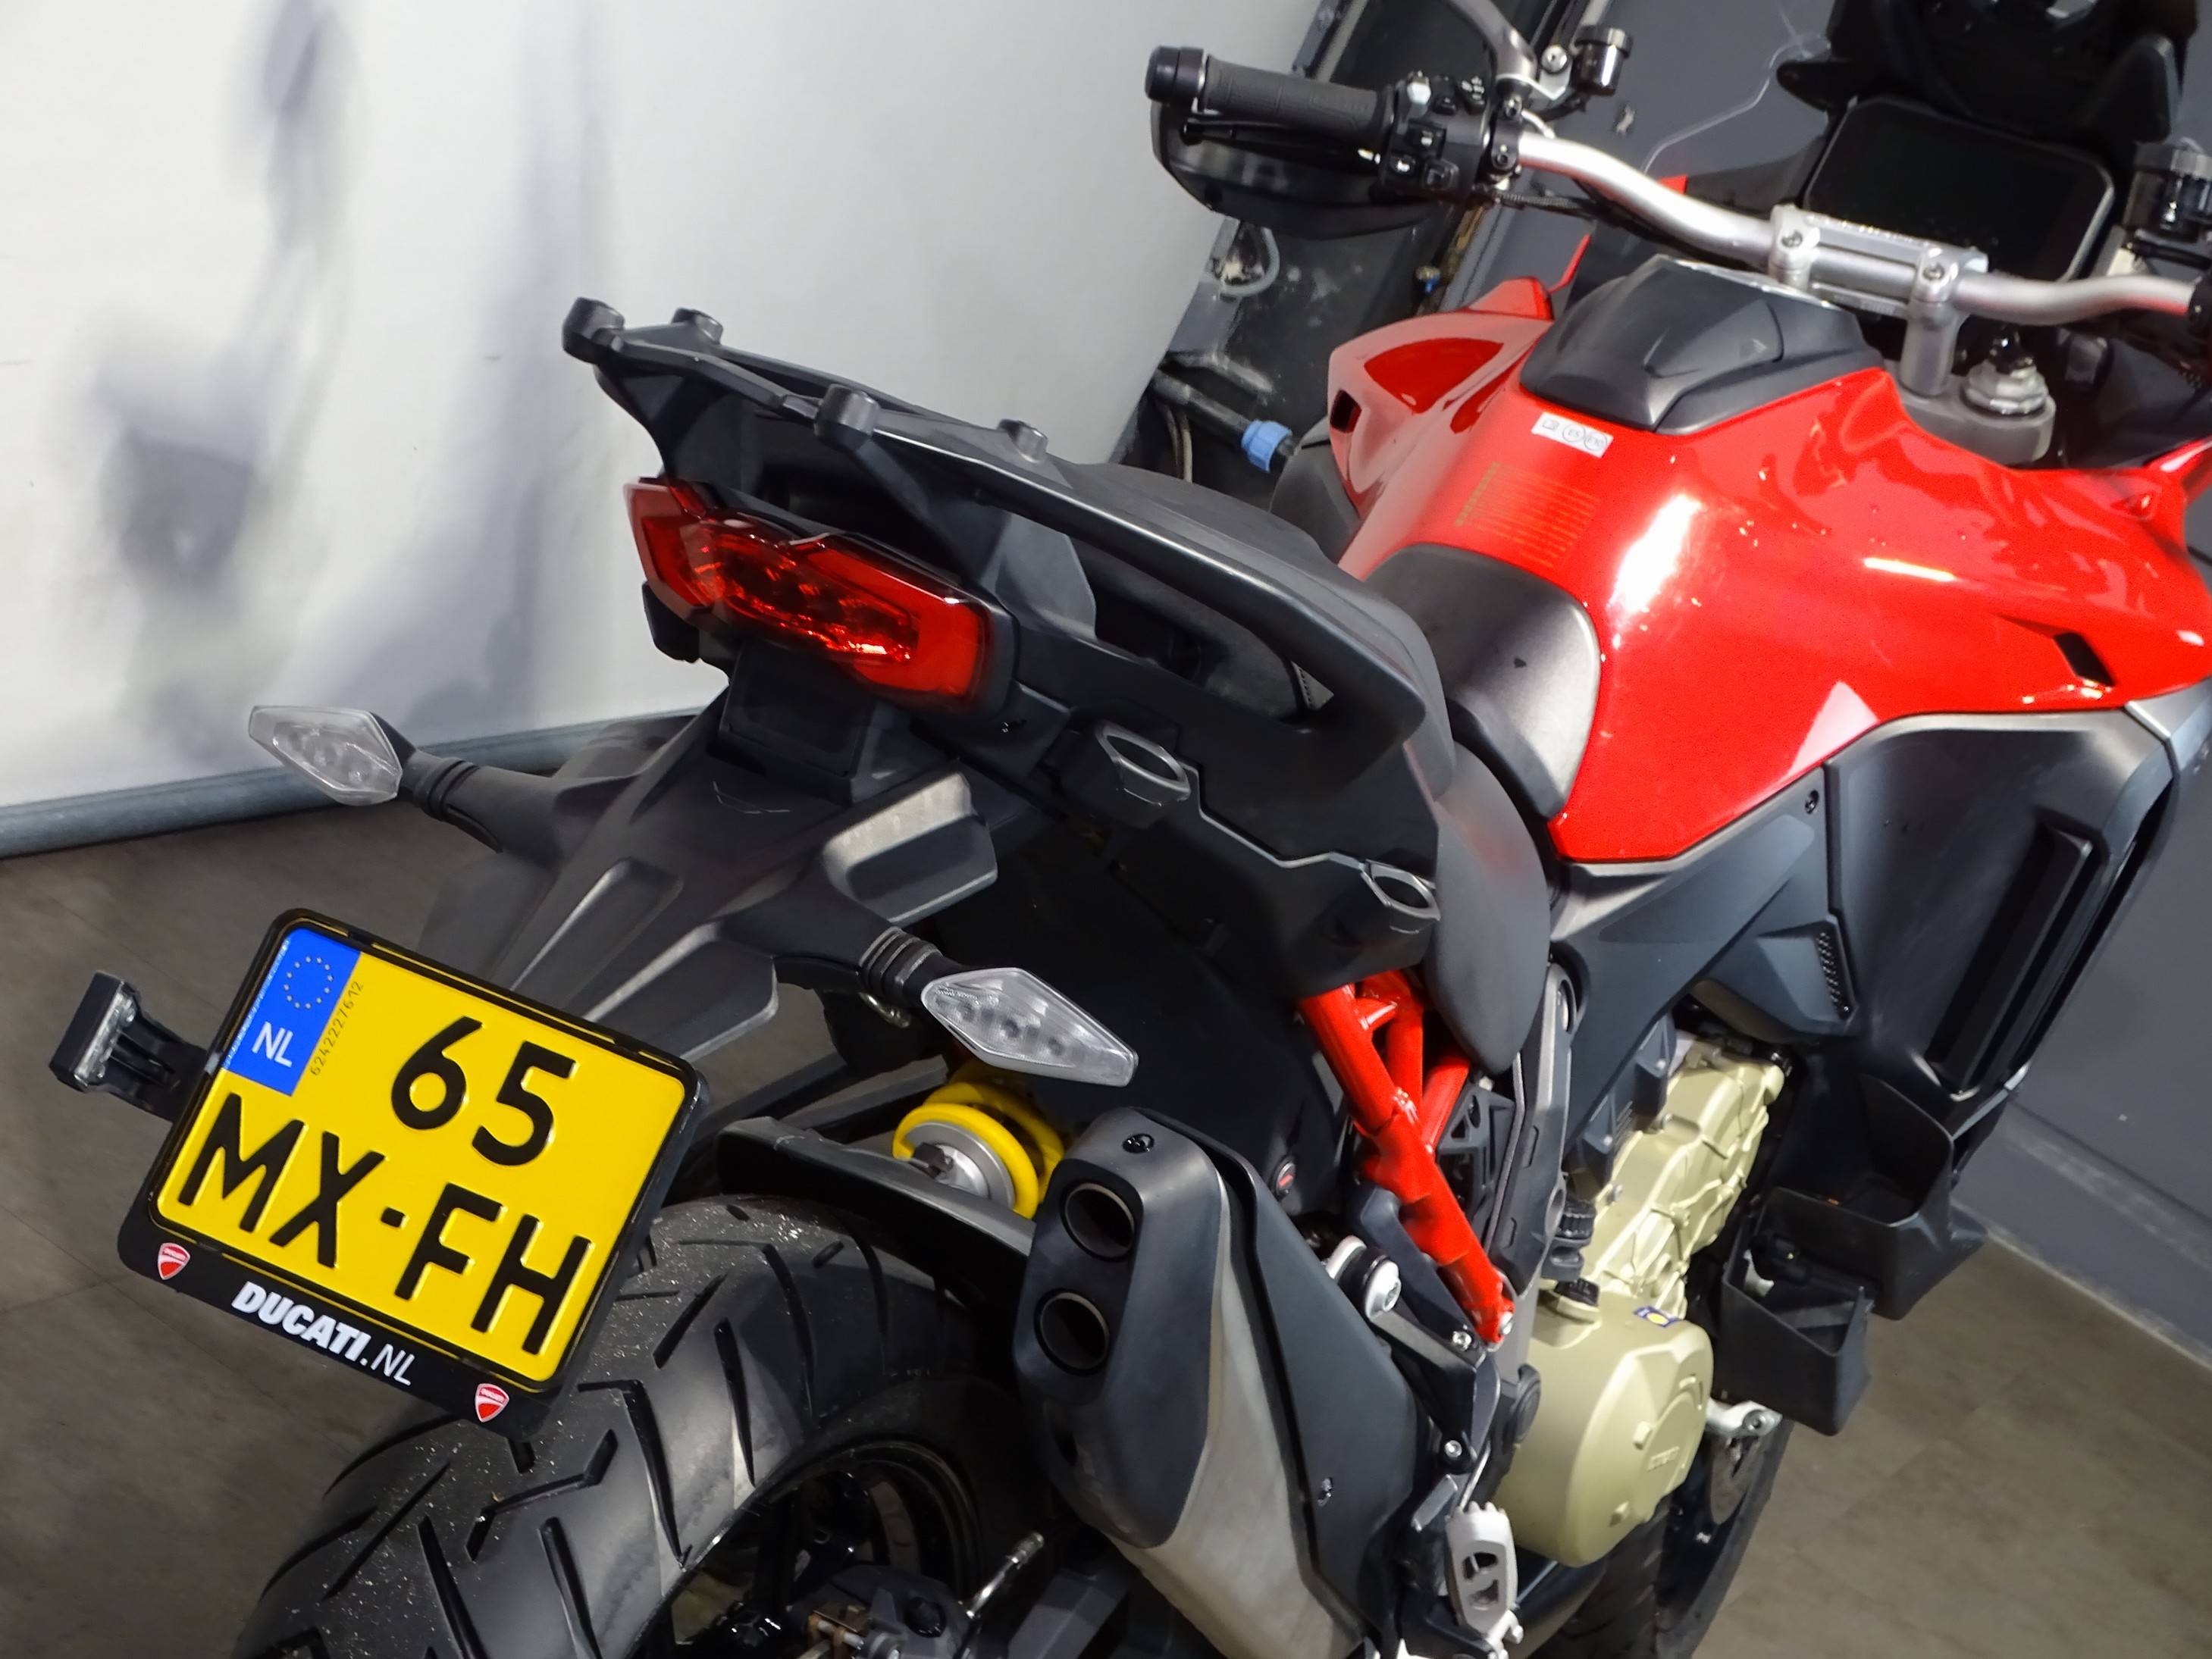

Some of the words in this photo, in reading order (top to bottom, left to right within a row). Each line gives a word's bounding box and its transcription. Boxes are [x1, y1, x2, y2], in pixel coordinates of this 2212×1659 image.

[251, 1021, 294, 1068] NL
[309, 981, 364, 1076] 6242227612
[391, 1016, 576, 1166] 65
[178, 1094, 591, 1355] MX-FH
